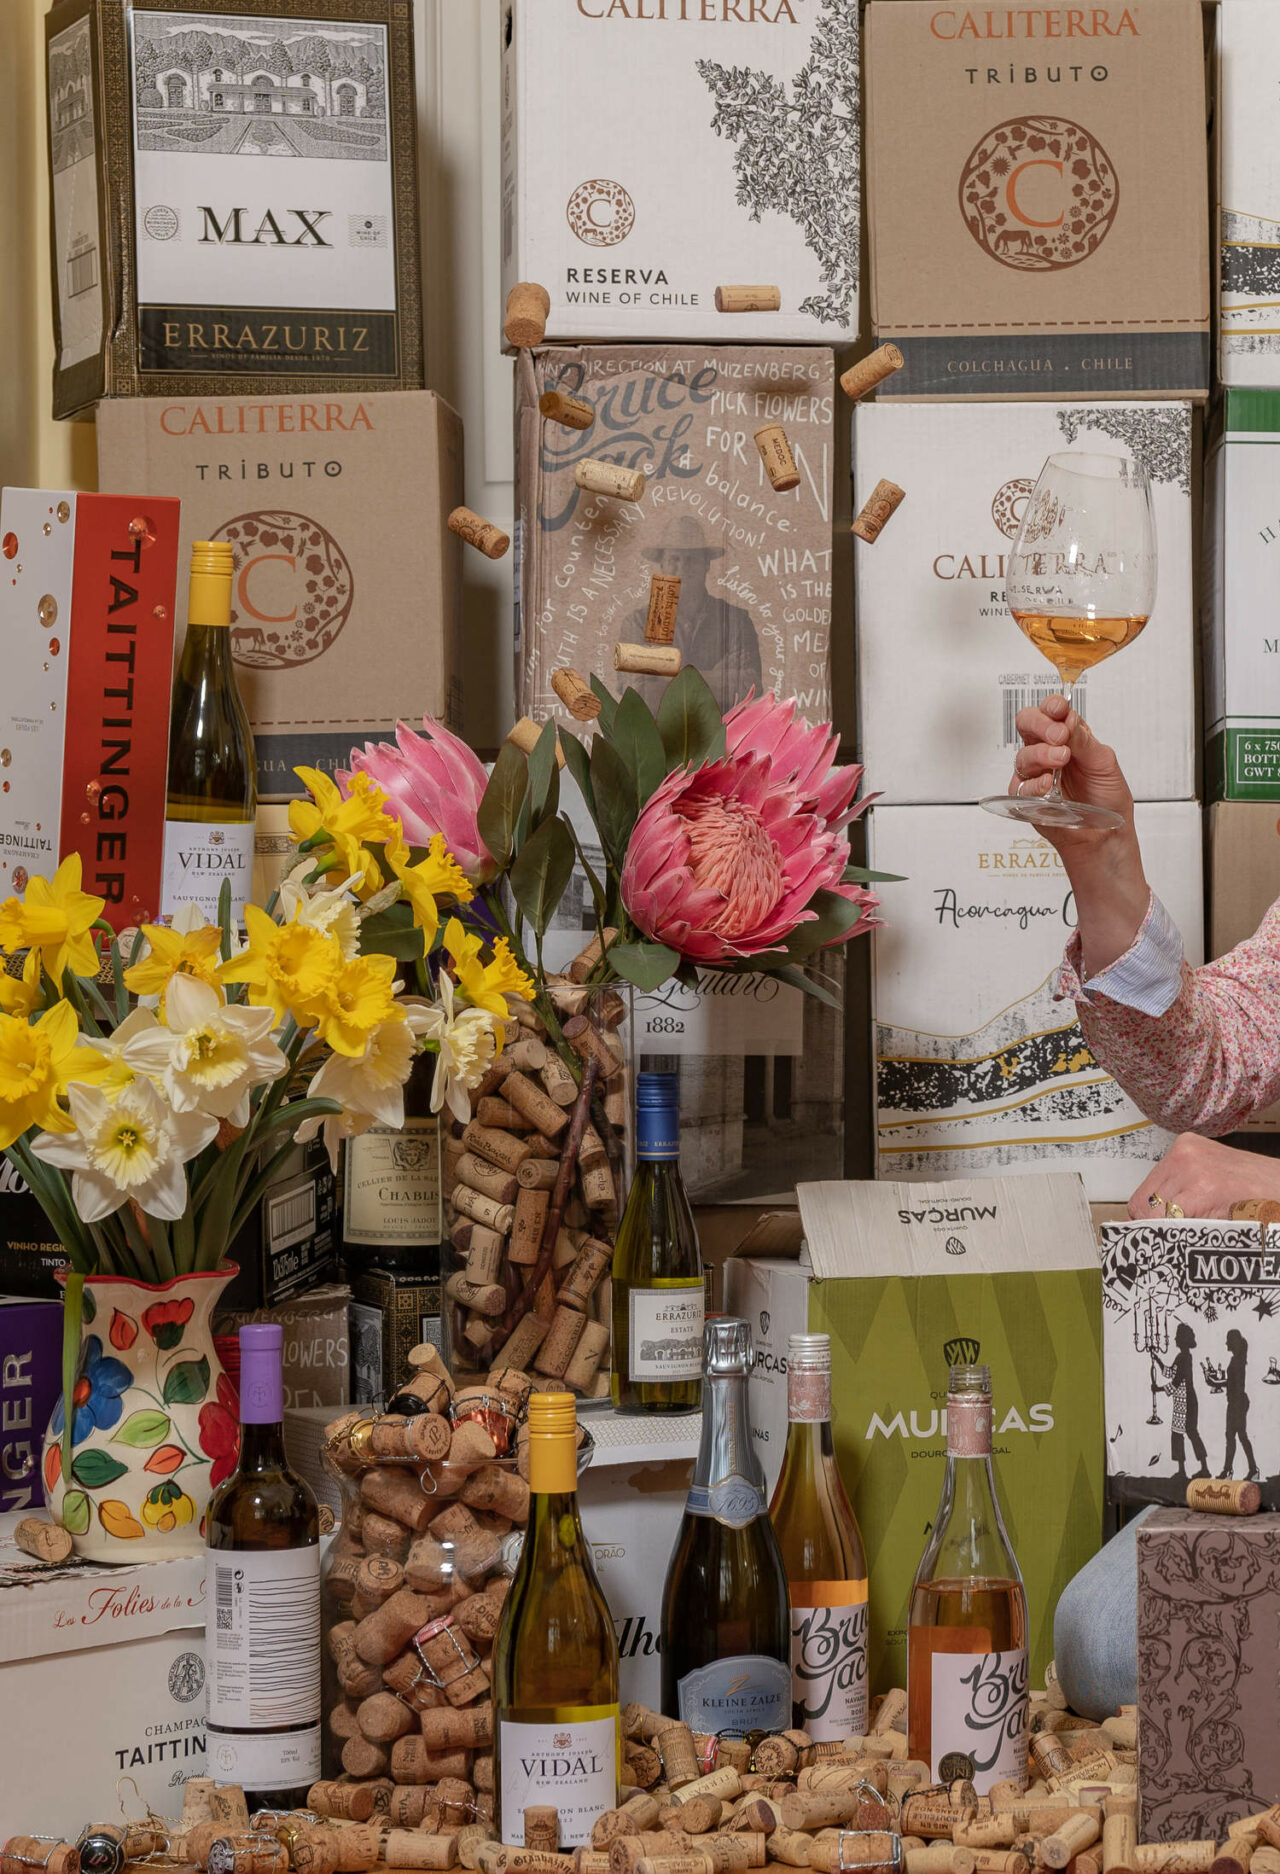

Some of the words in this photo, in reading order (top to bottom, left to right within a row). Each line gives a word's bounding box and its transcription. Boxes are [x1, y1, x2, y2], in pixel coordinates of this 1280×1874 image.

[930, 9, 1141, 40] CALITERRA
[197, 206, 335, 248] MAX
[566, 268, 669, 285] RESERVA
[566, 291, 611, 304] WINE
[619, 292, 642, 305] OF
[649, 293, 699, 306] CHILE
[163, 322, 370, 352] ERRAZURIZ
[672, 359, 696, 374] AT
[703, 358, 820, 381] MUIZENBERG
[947, 359, 1053, 373] COLCHAGUA
[1081, 357, 1133, 370] CHILE
[710, 388, 748, 416] PICK
[755, 391, 833, 425] FLOWERS
[160, 402, 376, 436] CALITERRA
[706, 425, 748, 466] FOR
[651, 483, 767, 550] REVOLUTION!
[589, 501, 647, 589] NECESSARY
[757, 547, 833, 577] WHAT
[581, 586, 600, 601] A
[717, 565, 759, 605] Listen
[759, 602, 773, 618] to
[801, 580, 833, 598] THE
[566, 602, 588, 625] IS
[979, 608, 1010, 617] WINE
[809, 662, 827, 679] OF
[95, 539, 143, 905] TAITTINGER
[1244, 741, 1251, 751] 6
[1255, 743, 1261, 751] x
[1243, 767, 1274, 777] GWT
[177, 852, 247, 869] VIDAL
[933, 888, 1058, 930] Aconcagua
[645, 1017, 685, 1034] 1882
[897, 1205, 997, 1225] MURÇAS
[7, 1240, 38, 1252] VINHO
[41, 1258, 66, 1268] TINTO
[864, 1403, 1055, 1440] MUAS
[81, 1585, 155, 1625] Folies
[702, 1697, 747, 1707] KLEINE
[750, 1694, 783, 1706] ZALZE
[731, 1718, 759, 1727] BRUT
[520, 1755, 604, 1778] VIDAL
[942, 1766, 973, 1778] WINE
[578, 1804, 605, 1814] BLANC
